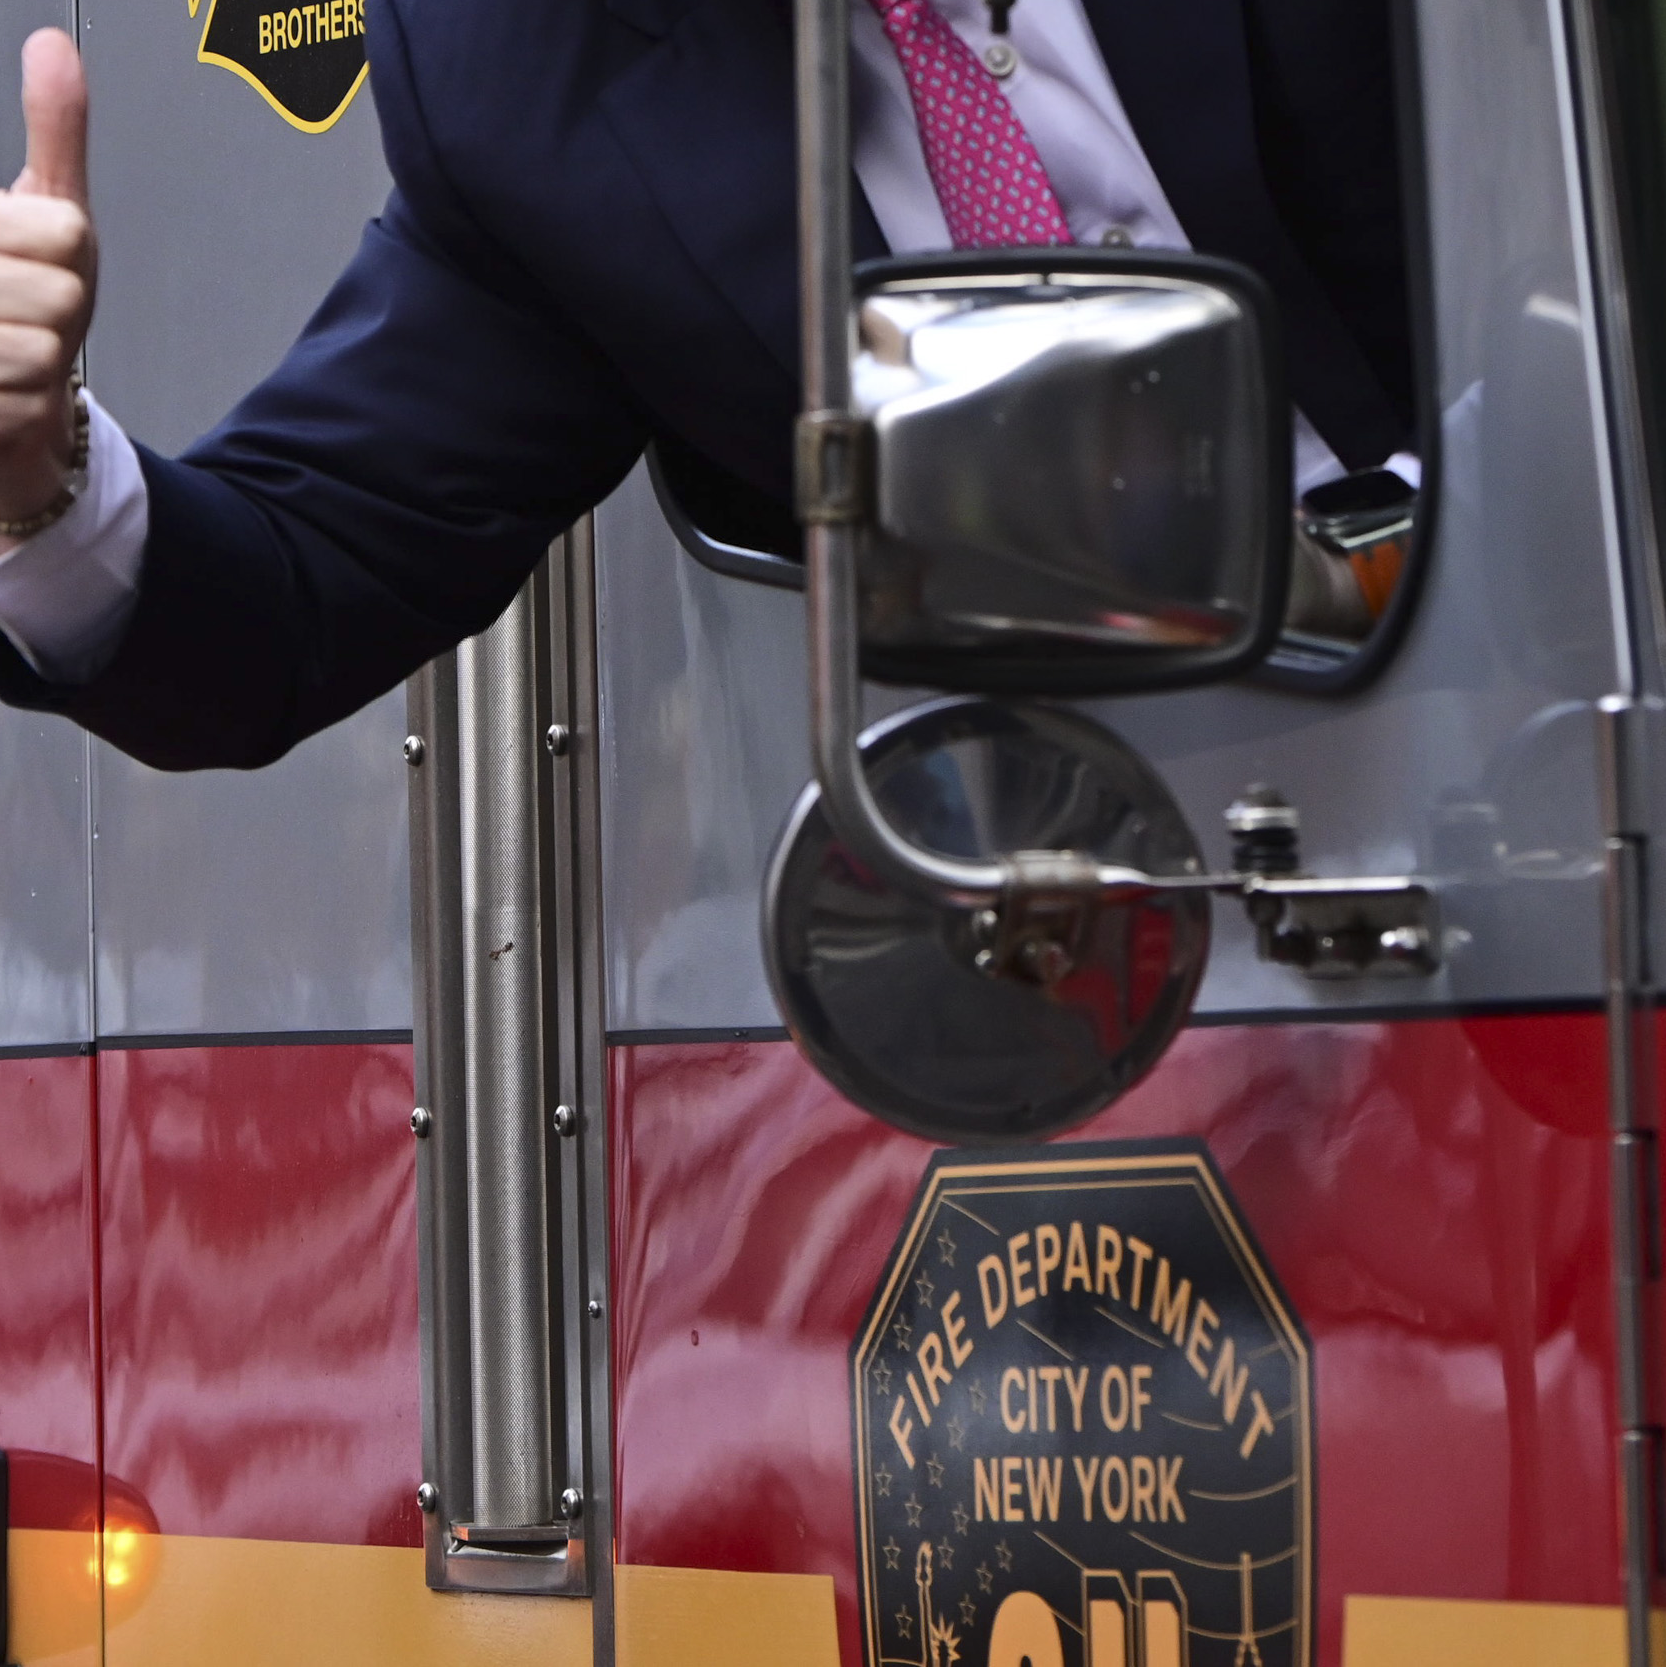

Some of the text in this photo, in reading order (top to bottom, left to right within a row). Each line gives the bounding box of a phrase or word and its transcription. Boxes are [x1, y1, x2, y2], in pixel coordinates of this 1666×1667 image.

[888, 1220, 1275, 1470] FIRE DEPARTMENT
[999, 1364, 1152, 1434] CITY OF
[973, 1455, 1187, 1524] NEW YORK
